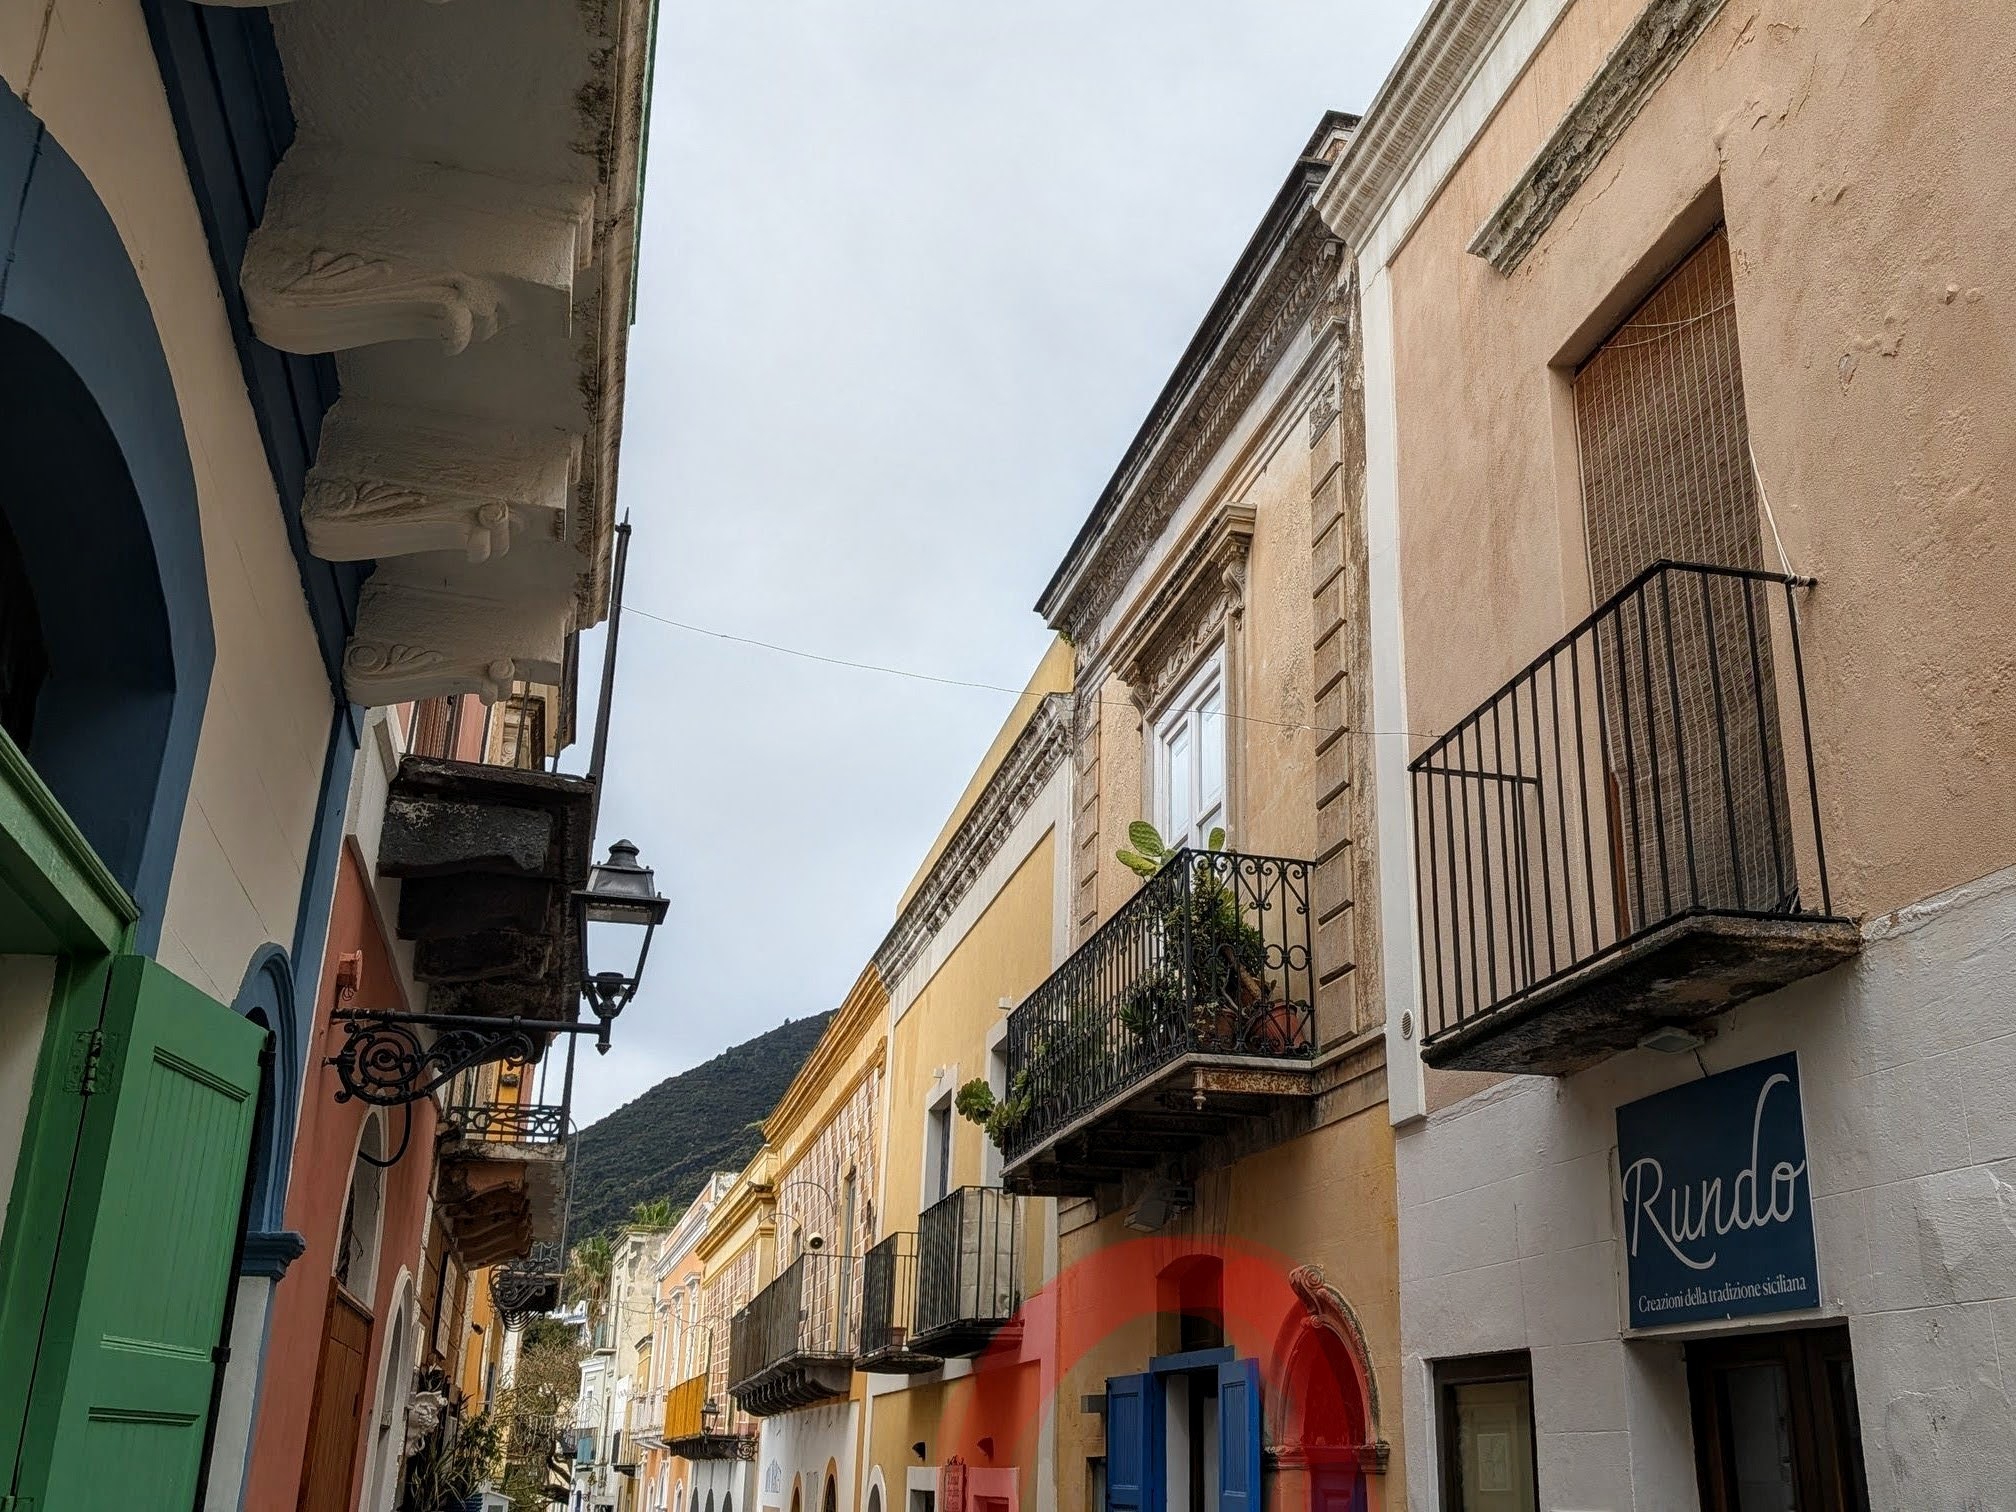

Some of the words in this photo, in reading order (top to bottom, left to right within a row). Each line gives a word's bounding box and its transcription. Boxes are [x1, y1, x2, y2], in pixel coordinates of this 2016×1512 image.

[1623, 1073, 1806, 1270] Rundo
[1638, 1291, 1684, 1313] Creazioni
[1684, 1286, 1707, 1306] della
[1708, 1281, 1762, 1302] tradizione
[1762, 1273, 1807, 1296] siciliana
